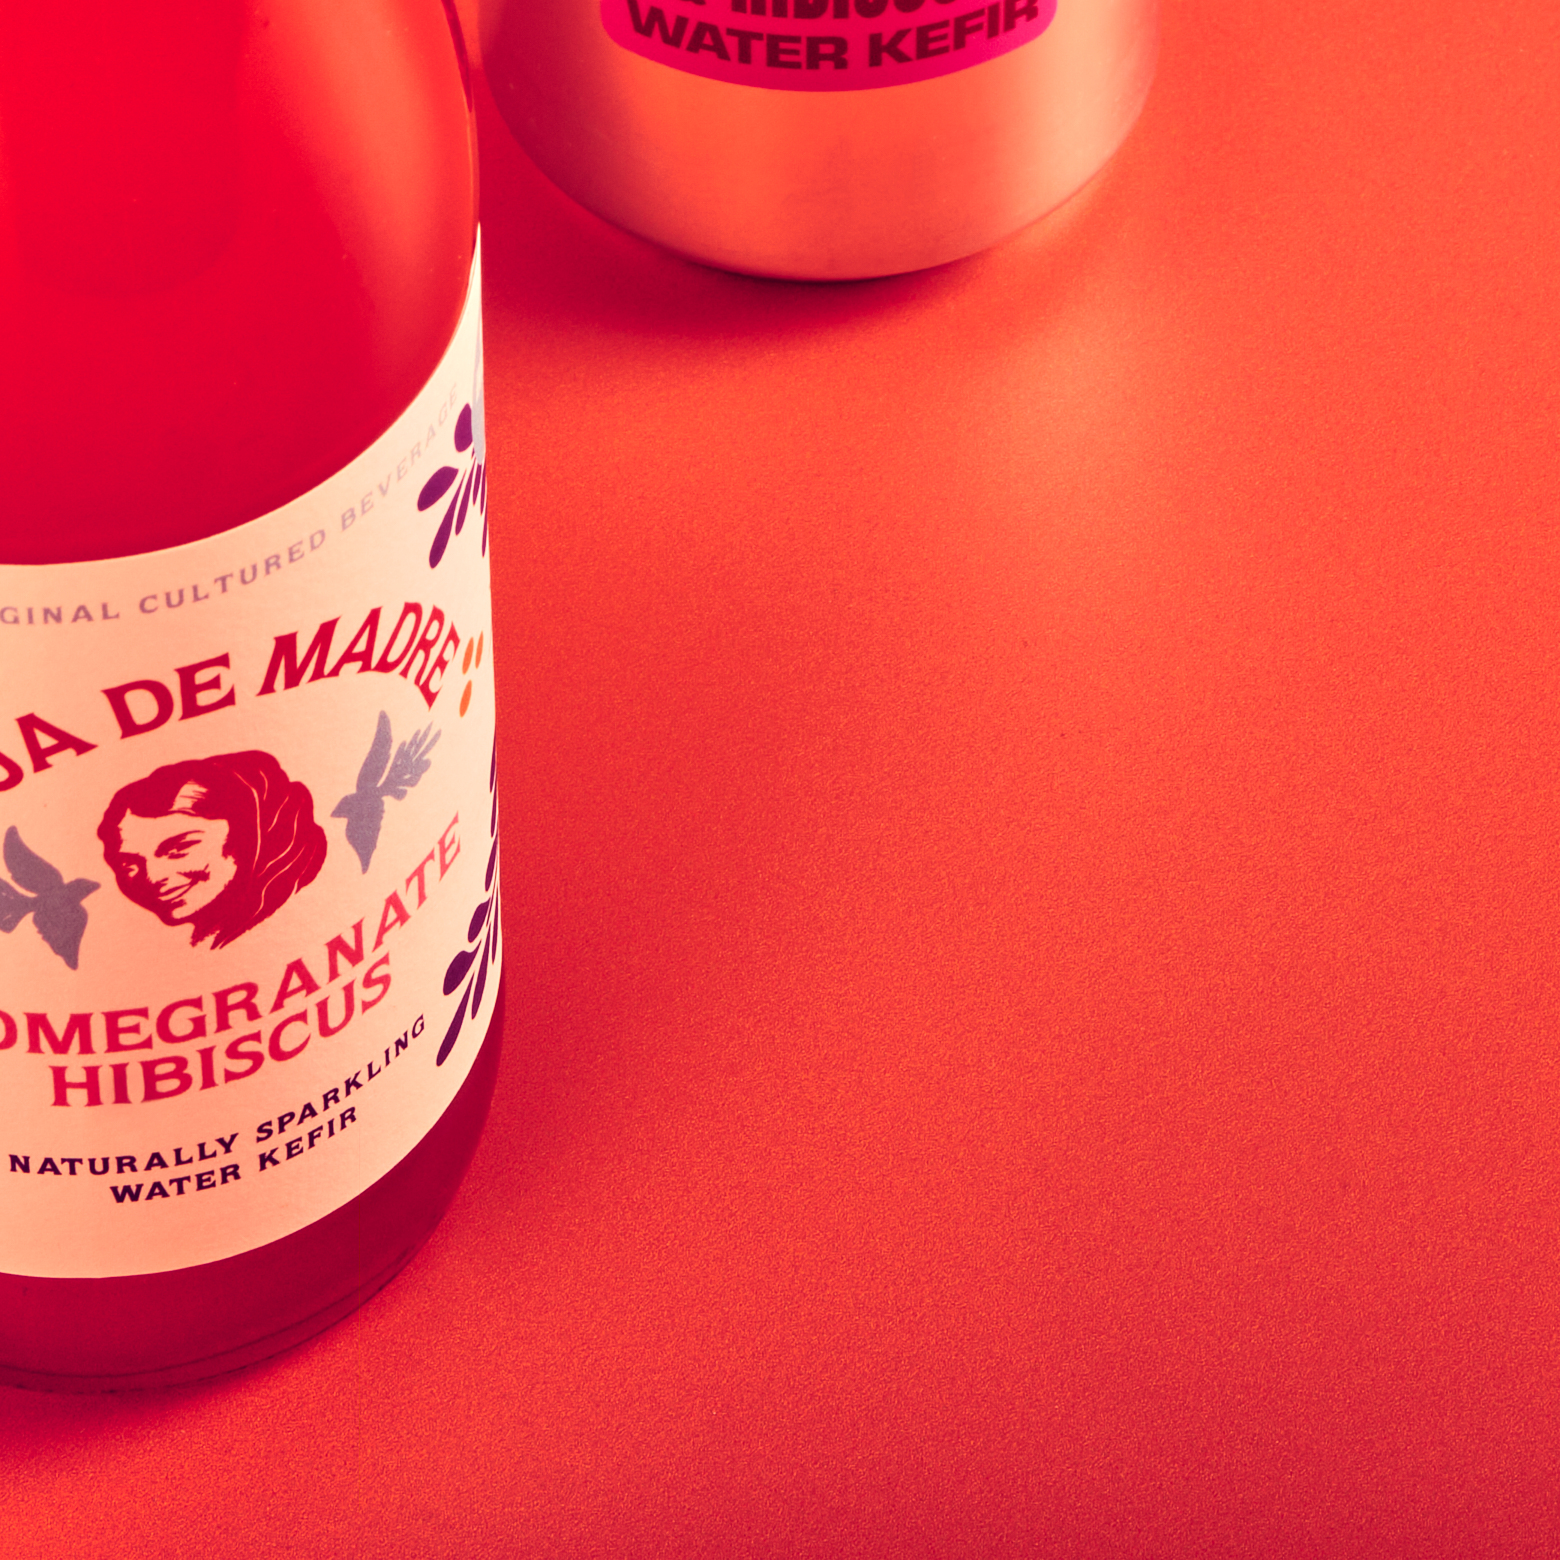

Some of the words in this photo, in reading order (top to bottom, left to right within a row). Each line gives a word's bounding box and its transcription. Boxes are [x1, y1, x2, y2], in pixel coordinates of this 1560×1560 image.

[139, 528, 327, 614] CULTURED
[339, 382, 459, 532] BEVERAGE
[100, 652, 237, 739] DE
[256, 600, 463, 711] MADRE
[8, 1131, 240, 1176] NATURALLY
[255, 1012, 426, 1143] SPARKLING
[50, 952, 393, 1108] HIBISCUS
[109, 1163, 243, 1204] WATER
[257, 1105, 359, 1171] KEFIR
